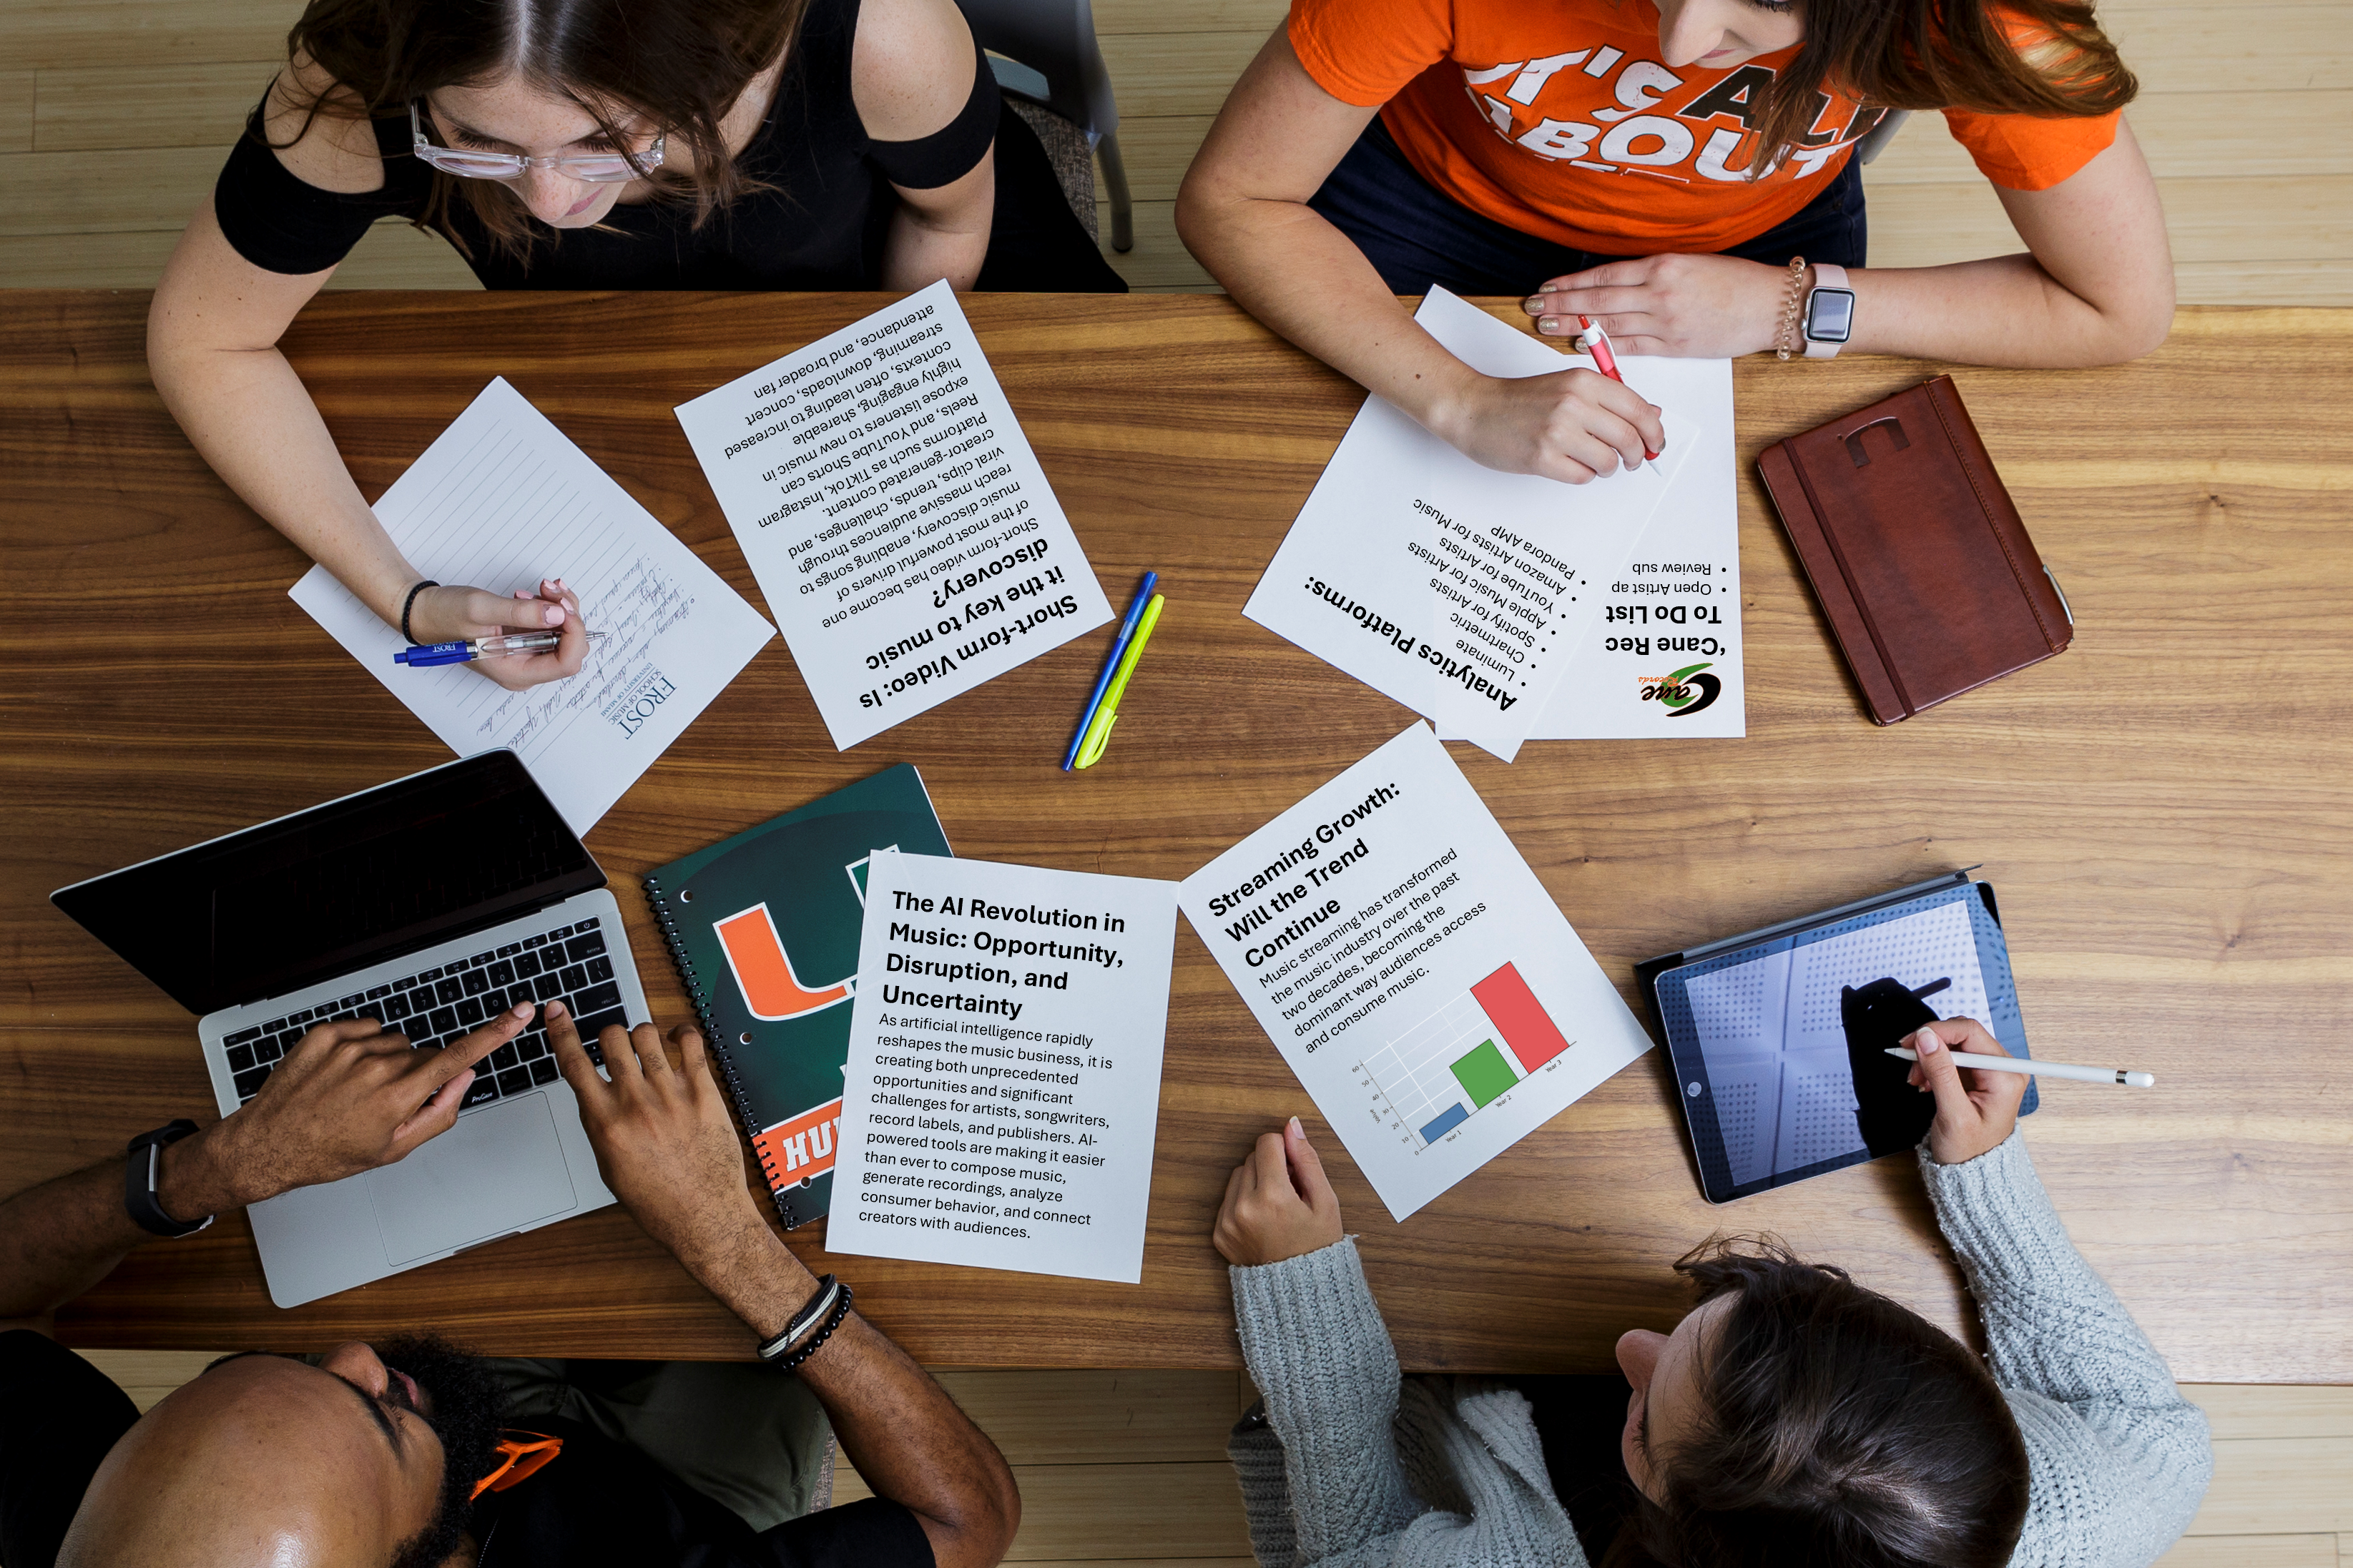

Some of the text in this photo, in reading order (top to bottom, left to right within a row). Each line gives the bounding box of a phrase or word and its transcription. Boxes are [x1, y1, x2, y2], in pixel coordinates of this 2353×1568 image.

[754, 305, 933, 398] attendance, and broader fan
[792, 358, 961, 444] highly engaging, shareable
[822, 430, 993, 517] creator-generated content.
[822, 518, 1038, 627] Short-form video has become one
[934, 539, 1048, 608] discovery?
[1414, 500, 1566, 595] Amazon Artists for Music
[1491, 526, 1575, 580] Pandora AMP
[1661, 564, 1710, 575] Review
[1408, 543, 1546, 629] Apple Music for Artists
[1440, 538, 1553, 614] YouTube for Artists
[1633, 584, 1670, 595] Artist
[1674, 581, 1711, 595] Open
[866, 566, 1065, 669] it the key to music
[1430, 578, 1535, 647] Spotify for Artists
[1450, 613, 1524, 663] Chartmetric
[1606, 606, 1721, 624] To Do List
[432, 644, 456, 653] FROST
[860, 596, 1076, 708] Short-form Video: Is
[1305, 577, 1517, 711] Analytics Platforms:
[1456, 640, 1515, 681] Luminate
[609, 671, 662, 724] SCHOOL OF MUSIC
[624, 663, 652, 691] UNIVERSITY
[1637, 676, 1679, 686] Records
[601, 701, 617, 716] MIAMI
[617, 675, 677, 740] FROST
[1209, 784, 1400, 917] Streaming Growth:
[893, 891, 1124, 932] The AI Revolution in
[1224, 838, 1369, 942] Will the Trend
[890, 922, 1122, 967] Music: Opportunity,
[1246, 900, 1340, 967] Continue
[1259, 848, 1457, 988] Music streaming has transformed
[1272, 872, 1460, 1004] the music industry over the past
[887, 953, 1068, 990] Disruption, and
[1282, 907, 1445, 1020] two decades, becoming the
[1295, 903, 1485, 1036] dominant way audiences access
[883, 985, 1022, 1020] Uncertainty
[1306, 968, 1429, 1052] and consume music.
[878, 1035, 1112, 1068] reshapes the music business, it is
[879, 1013, 1093, 1049] As artificial intelligence rapidly
[874, 1075, 1073, 1104] opportunities and significant
[876, 1055, 1078, 1085] creating both unprecedented
[1545, 1064, 1557, 1073] Year
[1495, 1099, 1507, 1108] Year
[782, 1116, 840, 1172] HU
[1445, 1133, 1457, 1143] Year
